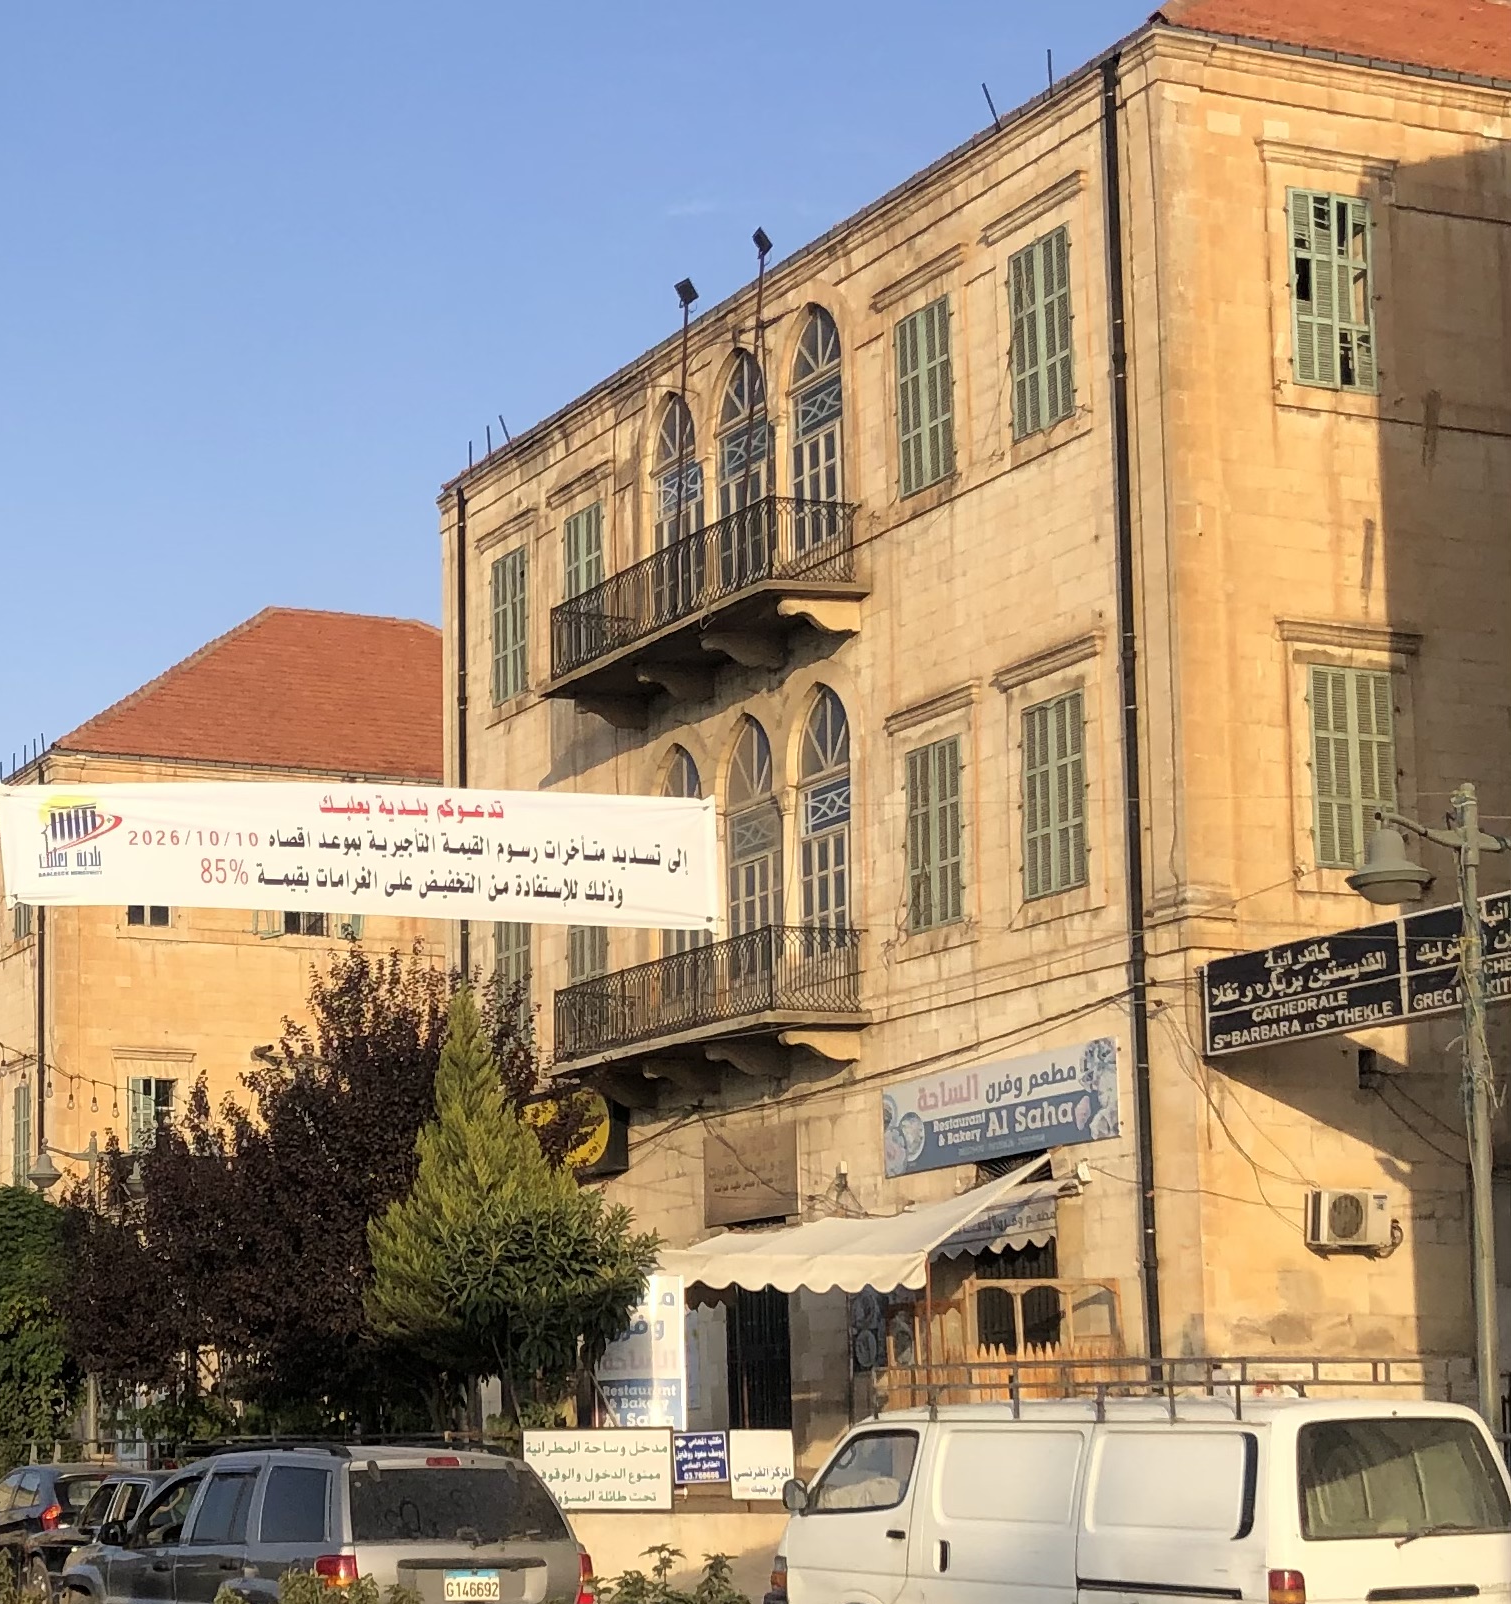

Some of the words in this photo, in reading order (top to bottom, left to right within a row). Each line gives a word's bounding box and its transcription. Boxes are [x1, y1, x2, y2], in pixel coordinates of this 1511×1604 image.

[318, 794, 371, 822] بعلبك
[375, 794, 429, 823] بلدية
[437, 797, 505, 824] تدعوكم
[127, 829, 259, 847] 2026/10/10
[366, 827, 436, 860] التأجيرية
[441, 830, 491, 856] القيمة
[544, 835, 606, 866] متأخرات
[496, 841, 539, 865] رسوم
[612, 843, 662, 871] تسديد
[667, 850, 688, 876] إلى
[200, 857, 249, 886] 85%
[255, 862, 310, 894] بقيمة
[315, 866, 379, 896] الغرامات
[384, 869, 414, 898] على
[418, 867, 482, 900] التخفيض
[487, 873, 510, 903] من
[584, 877, 624, 909] وذلك
[1251, 991, 1349, 1023] CATHEDRALE
[1412, 990, 1453, 1011] GREC
[917, 1073, 979, 1112] الساحة
[985, 1073, 1023, 1104] وفرن
[1026, 1062, 1077, 1096] مطعم
[932, 1111, 987, 1133] Restaurant
[986, 1109, 1010, 1138] Al
[1014, 1100, 1074, 1133] Saha
[938, 1134, 946, 1146] &
[947, 1129, 981, 1145] Bakery
[525, 1440, 581, 1457] المطرانية
[583, 1440, 626, 1457] وساحة
[629, 1440, 668, 1456] مدخل
[590, 1467, 626, 1483] الدخول
[628, 1469, 661, 1484] ممنوع
[630, 1491, 657, 1502] تحت
[446, 1581, 499, 1598] G146692
